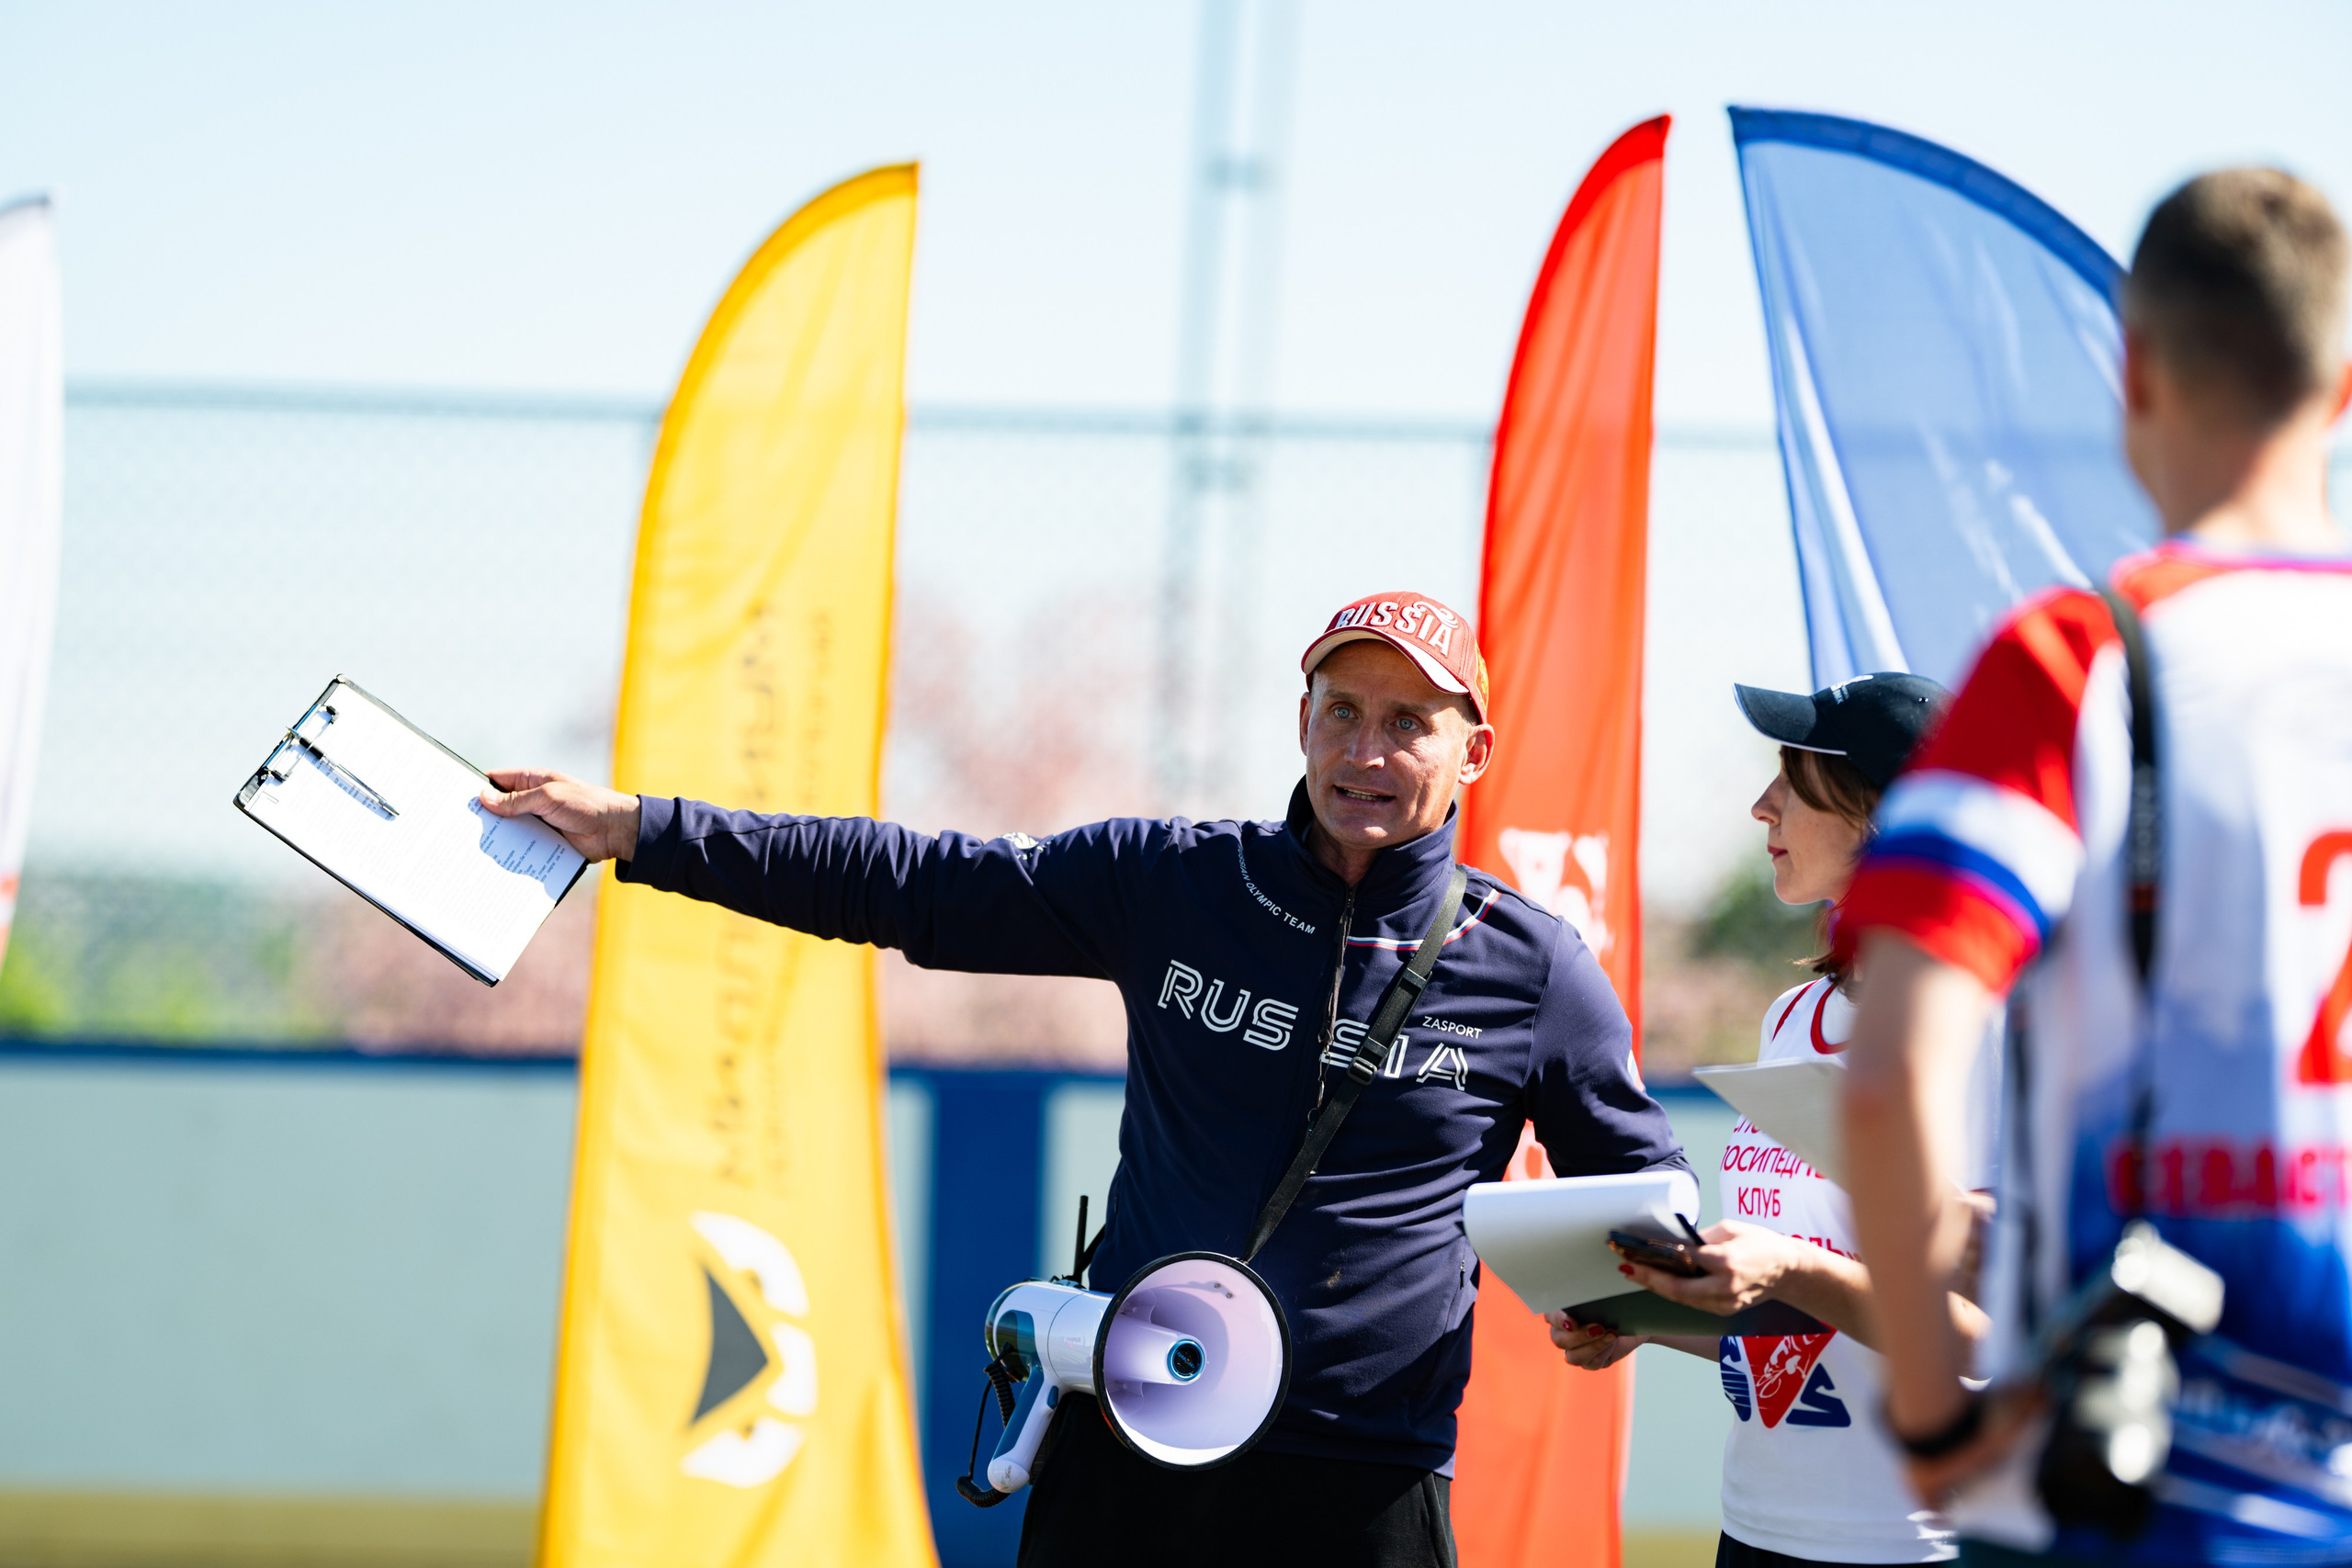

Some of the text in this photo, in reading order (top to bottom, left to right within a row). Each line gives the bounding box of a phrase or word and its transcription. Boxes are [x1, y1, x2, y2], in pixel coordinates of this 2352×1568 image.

[1335, 601, 1455, 657] RUSSIA
[1246, 882, 1282, 916] OLYMPIC
[1283, 912, 1316, 934] TEAM
[1422, 1015, 1483, 1040] ZASPORT
[1738, 1187, 1781, 1219] КЛУБ
